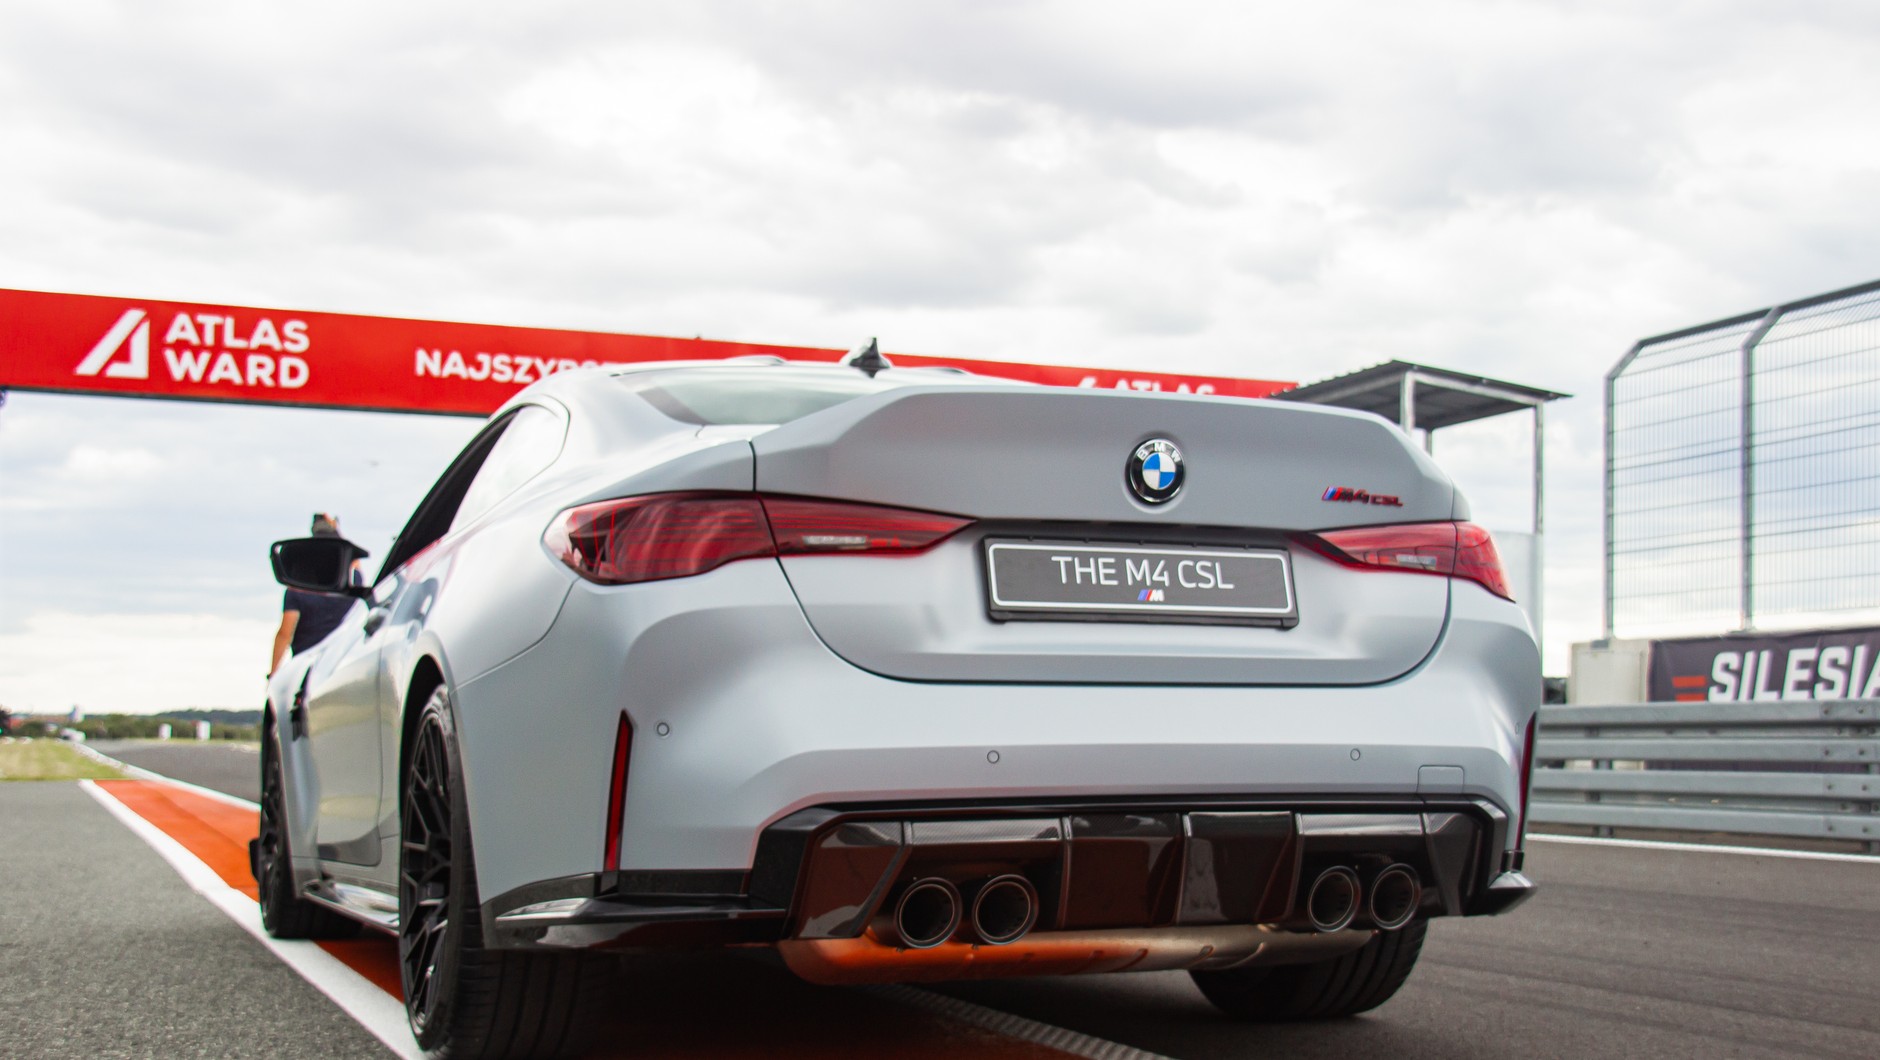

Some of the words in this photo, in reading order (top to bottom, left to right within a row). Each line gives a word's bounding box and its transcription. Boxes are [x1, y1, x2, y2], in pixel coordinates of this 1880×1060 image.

[164, 313, 310, 352] ATLAS
[163, 349, 310, 388] WARD
[415, 348, 604, 383] NAJSZY
[1136, 442, 1182, 462] BMW
[1370, 494, 1403, 507] CSL
[1051, 556, 1118, 585] THE
[1125, 559, 1170, 587] M4
[1178, 561, 1234, 589] CSL
